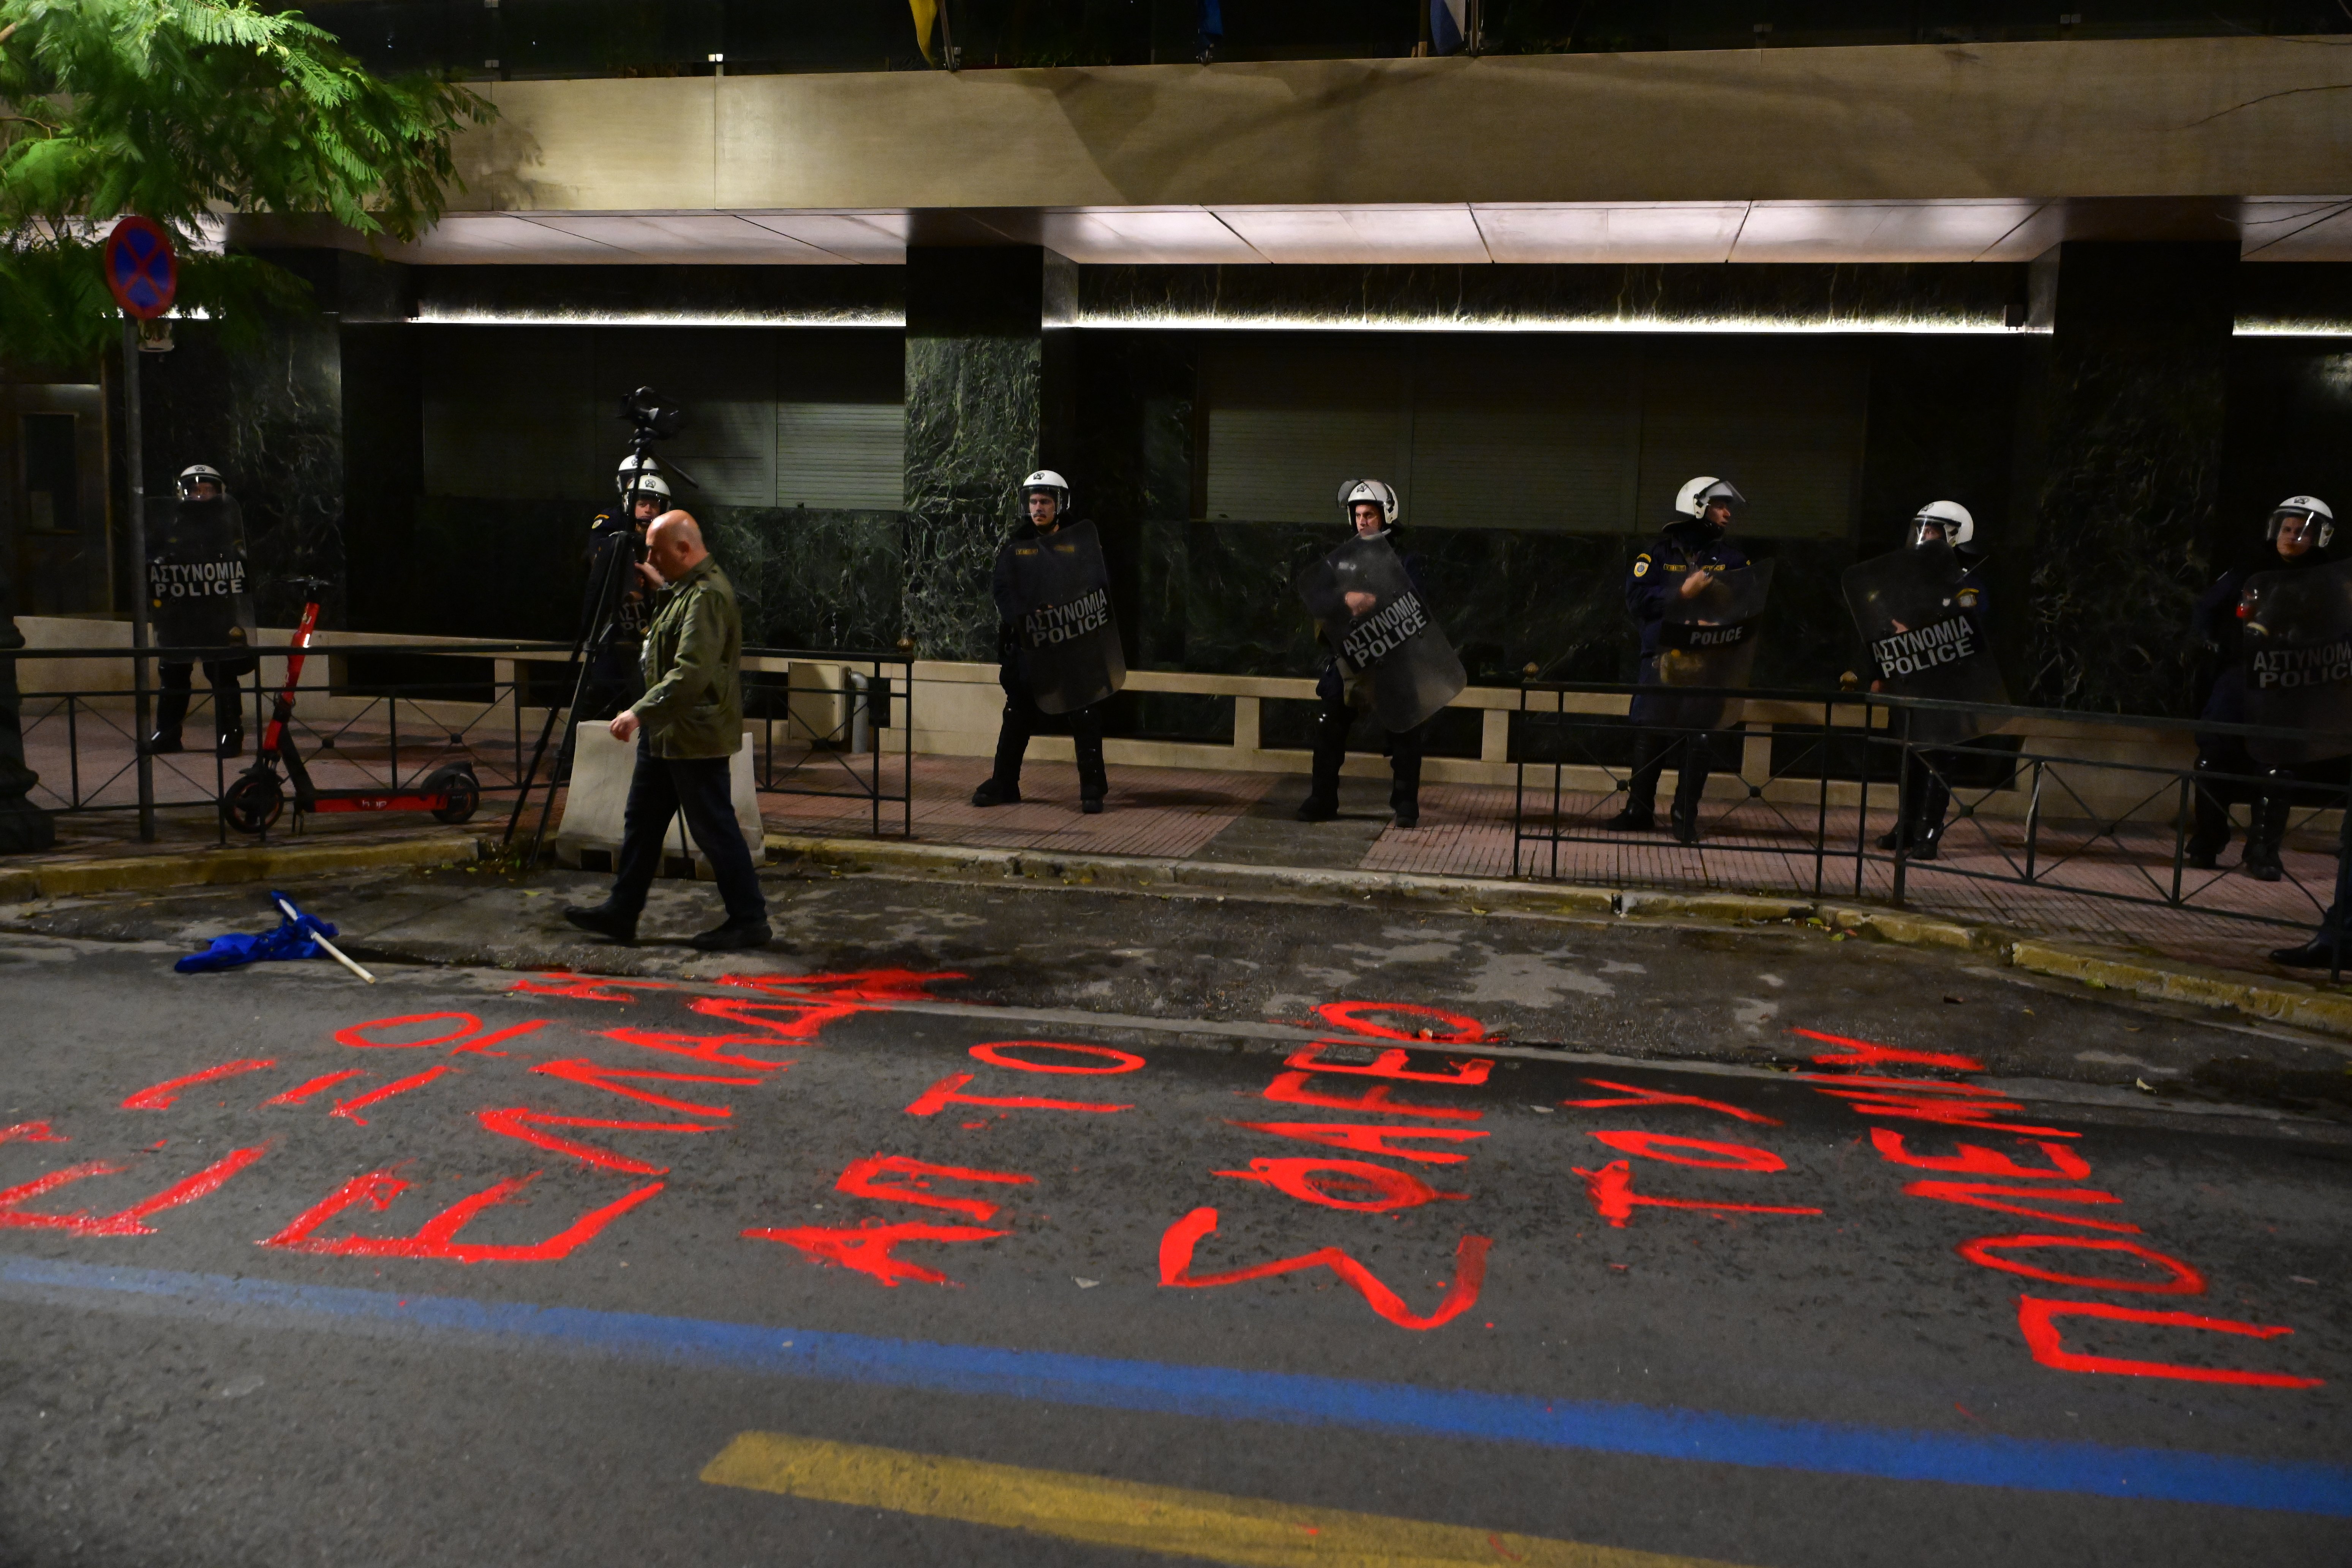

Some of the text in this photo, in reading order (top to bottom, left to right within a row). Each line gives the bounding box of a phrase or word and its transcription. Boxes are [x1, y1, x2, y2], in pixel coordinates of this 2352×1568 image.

[150, 561, 245, 582] ΑΣΤΥΝΟΜΙΑ
[155, 579, 243, 597] POLICE
[1026, 588, 1107, 633] ΑΣΤΥΝΟΜΙΑ
[1032, 607, 1108, 647] POLICE
[1343, 591, 1421, 656] ΑΣΤΥΝΟΜΙΑ
[1354, 610, 1427, 668] POLICE
[1690, 626, 1743, 645] POLICE
[1872, 615, 1974, 662] ΑΣΤΥΝΟΜΙΑ
[1881, 637, 1974, 678] POLICE
[2260, 660, 2352, 688] POLIC
[1557, 1078, 1823, 1228] ΤΟΥ
